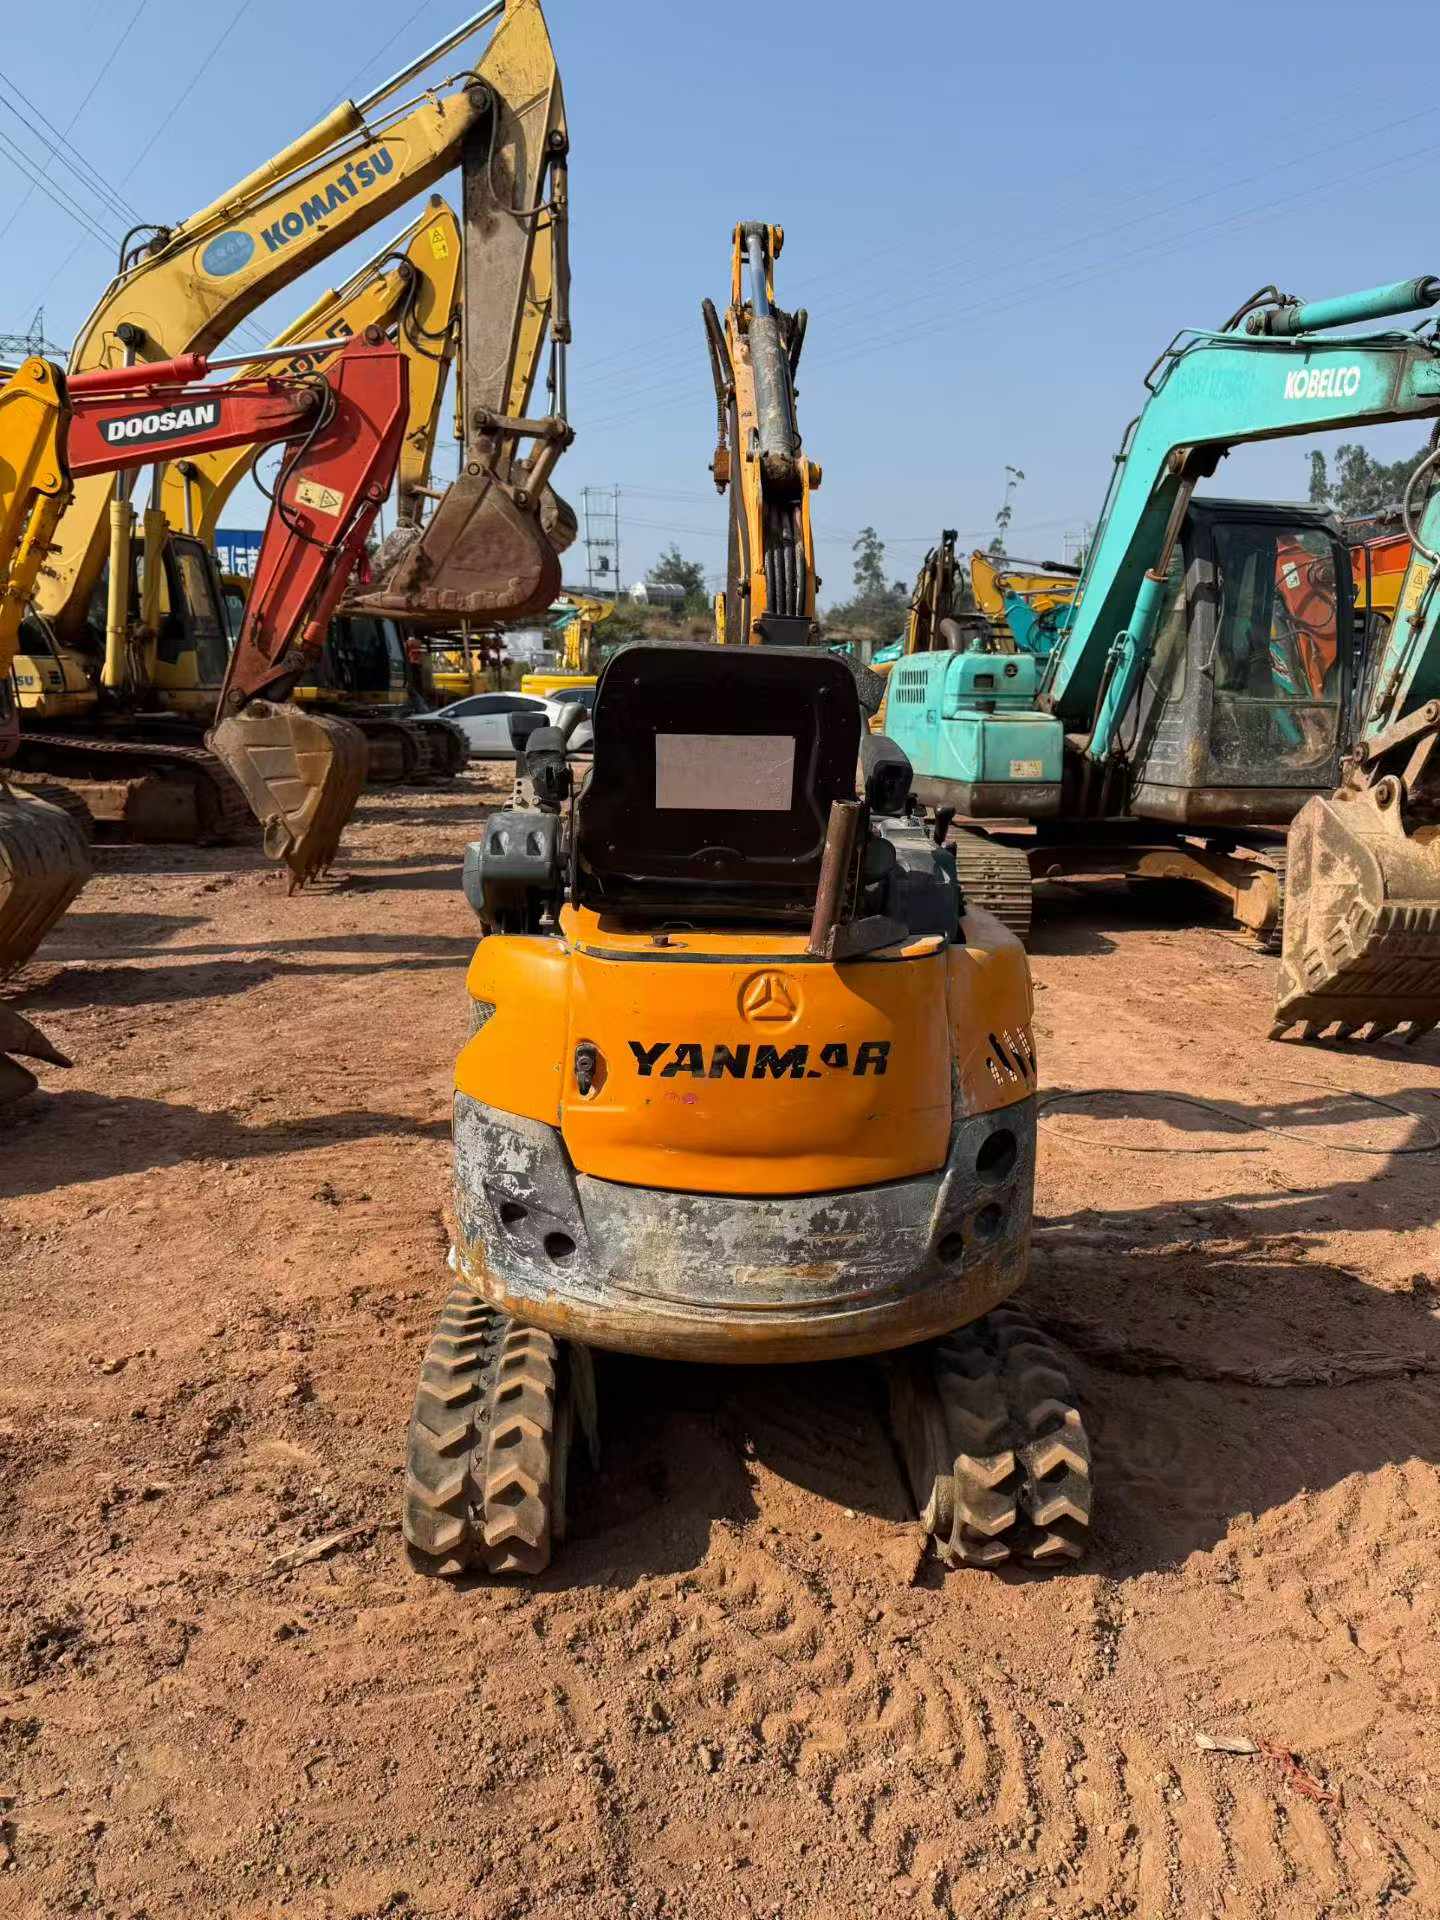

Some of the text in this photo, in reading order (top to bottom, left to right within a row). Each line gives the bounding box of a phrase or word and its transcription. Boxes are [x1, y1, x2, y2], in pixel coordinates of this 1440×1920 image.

[261, 147, 393, 252] KOMATSU
[1284, 367, 1360, 399] KOBELCO
[108, 404, 214, 441] DOOSAN
